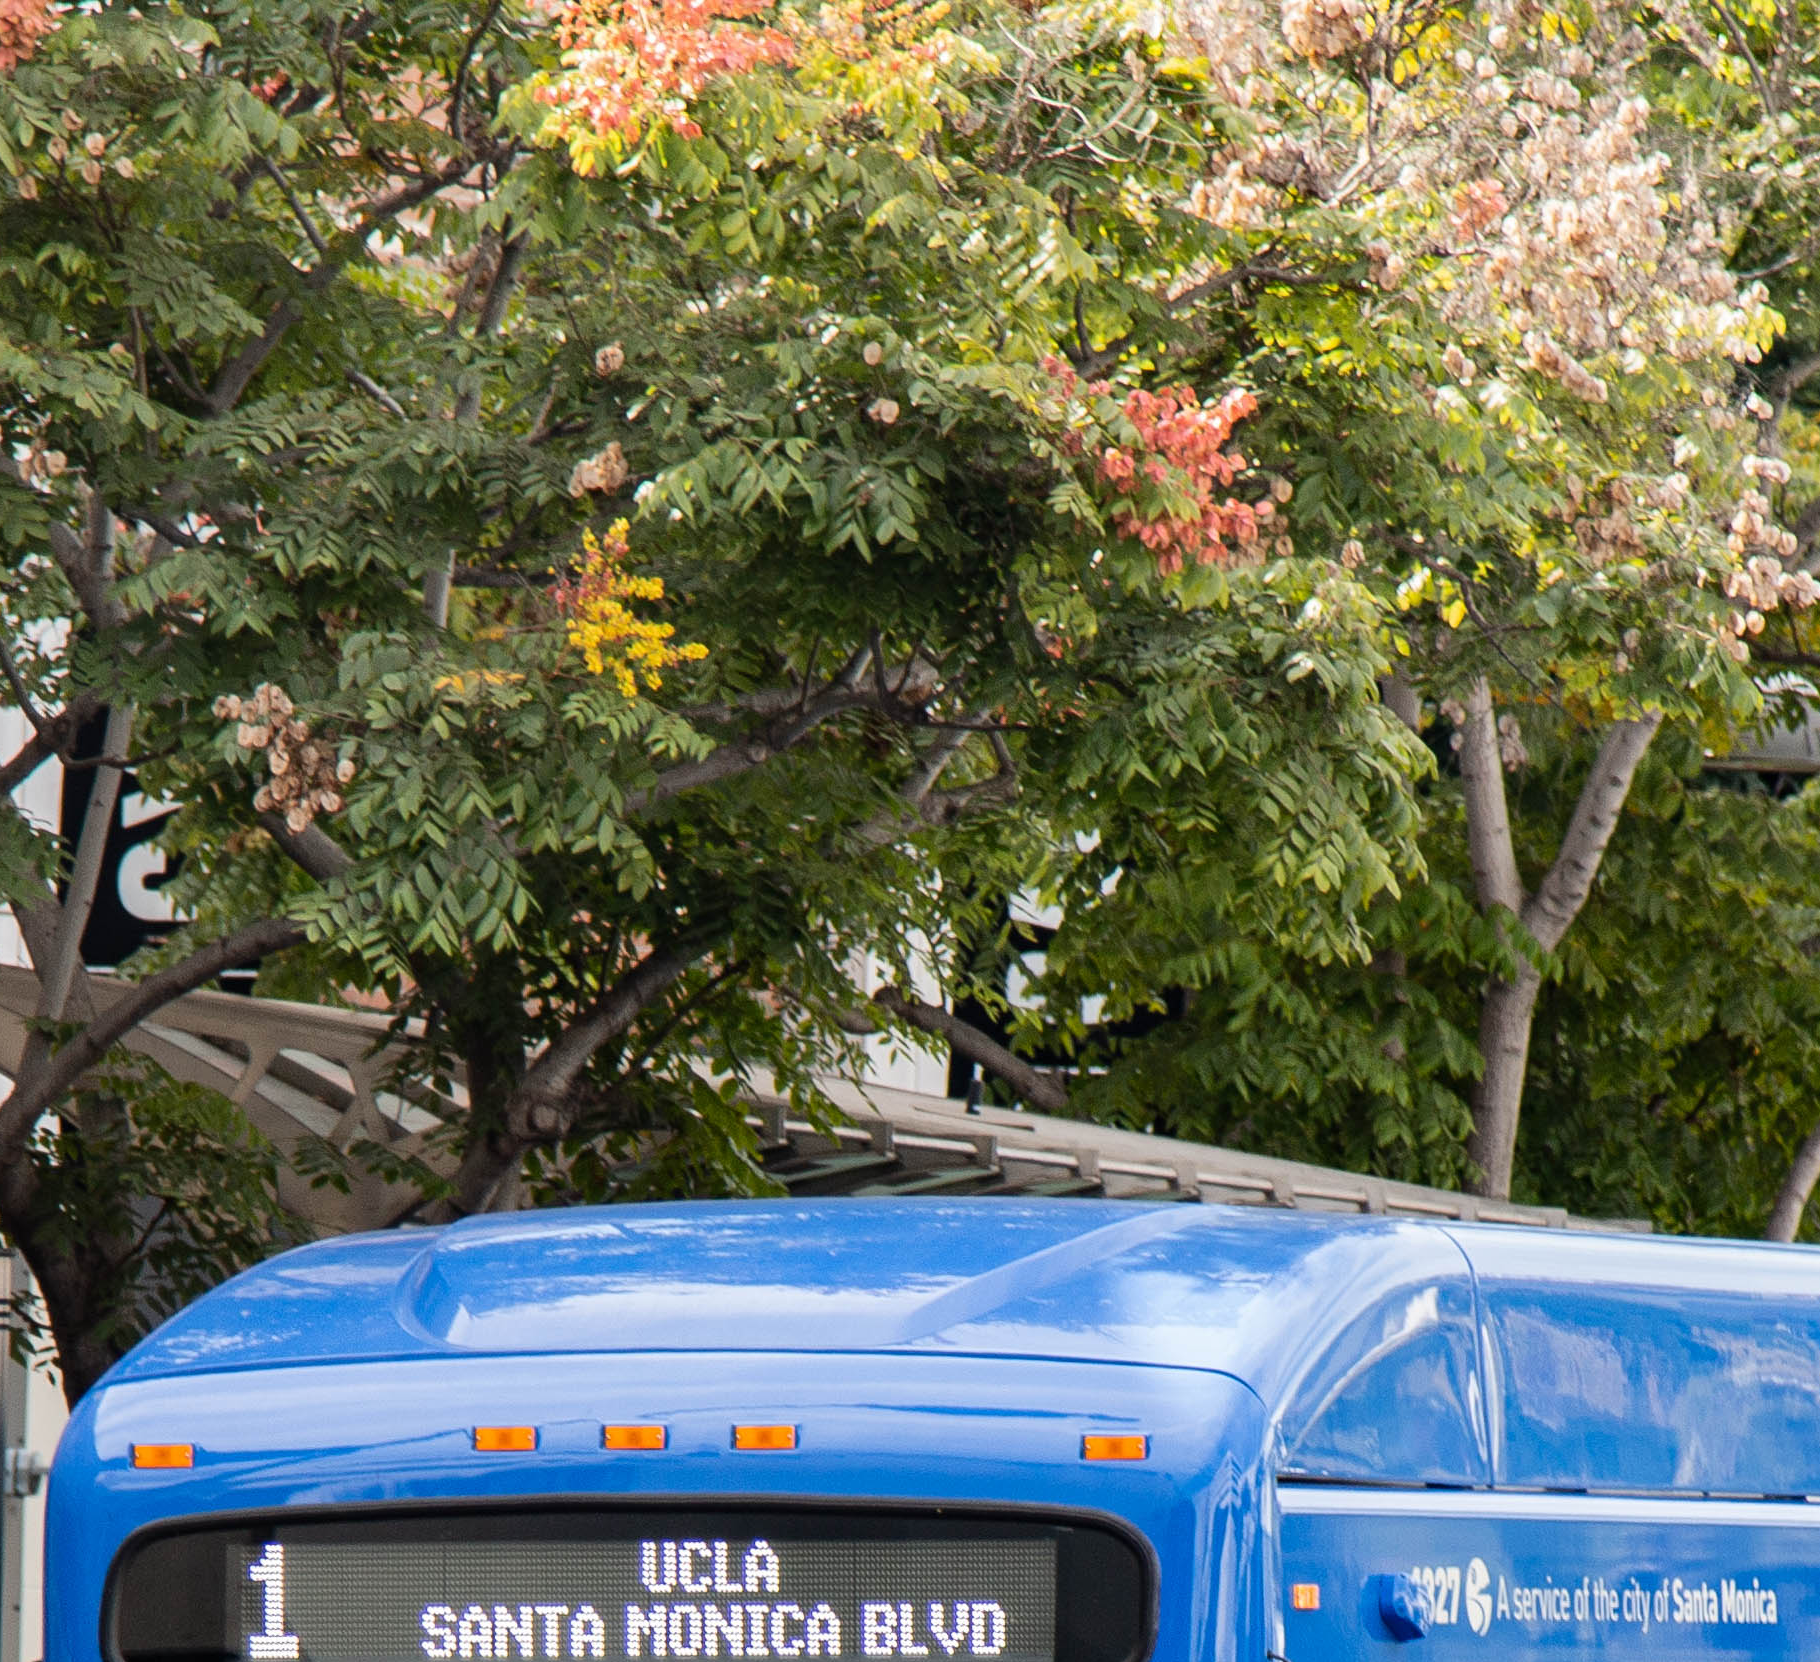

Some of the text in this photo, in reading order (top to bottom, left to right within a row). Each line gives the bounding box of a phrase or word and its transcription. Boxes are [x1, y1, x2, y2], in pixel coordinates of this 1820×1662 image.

[640, 1539, 779, 1594] UCLA
[247, 1542, 300, 1659] 1
[421, 1600, 1007, 1658] SANTA MONICA BLVD
[1497, 1576, 1778, 1634] A service of the city of Santa Monica
